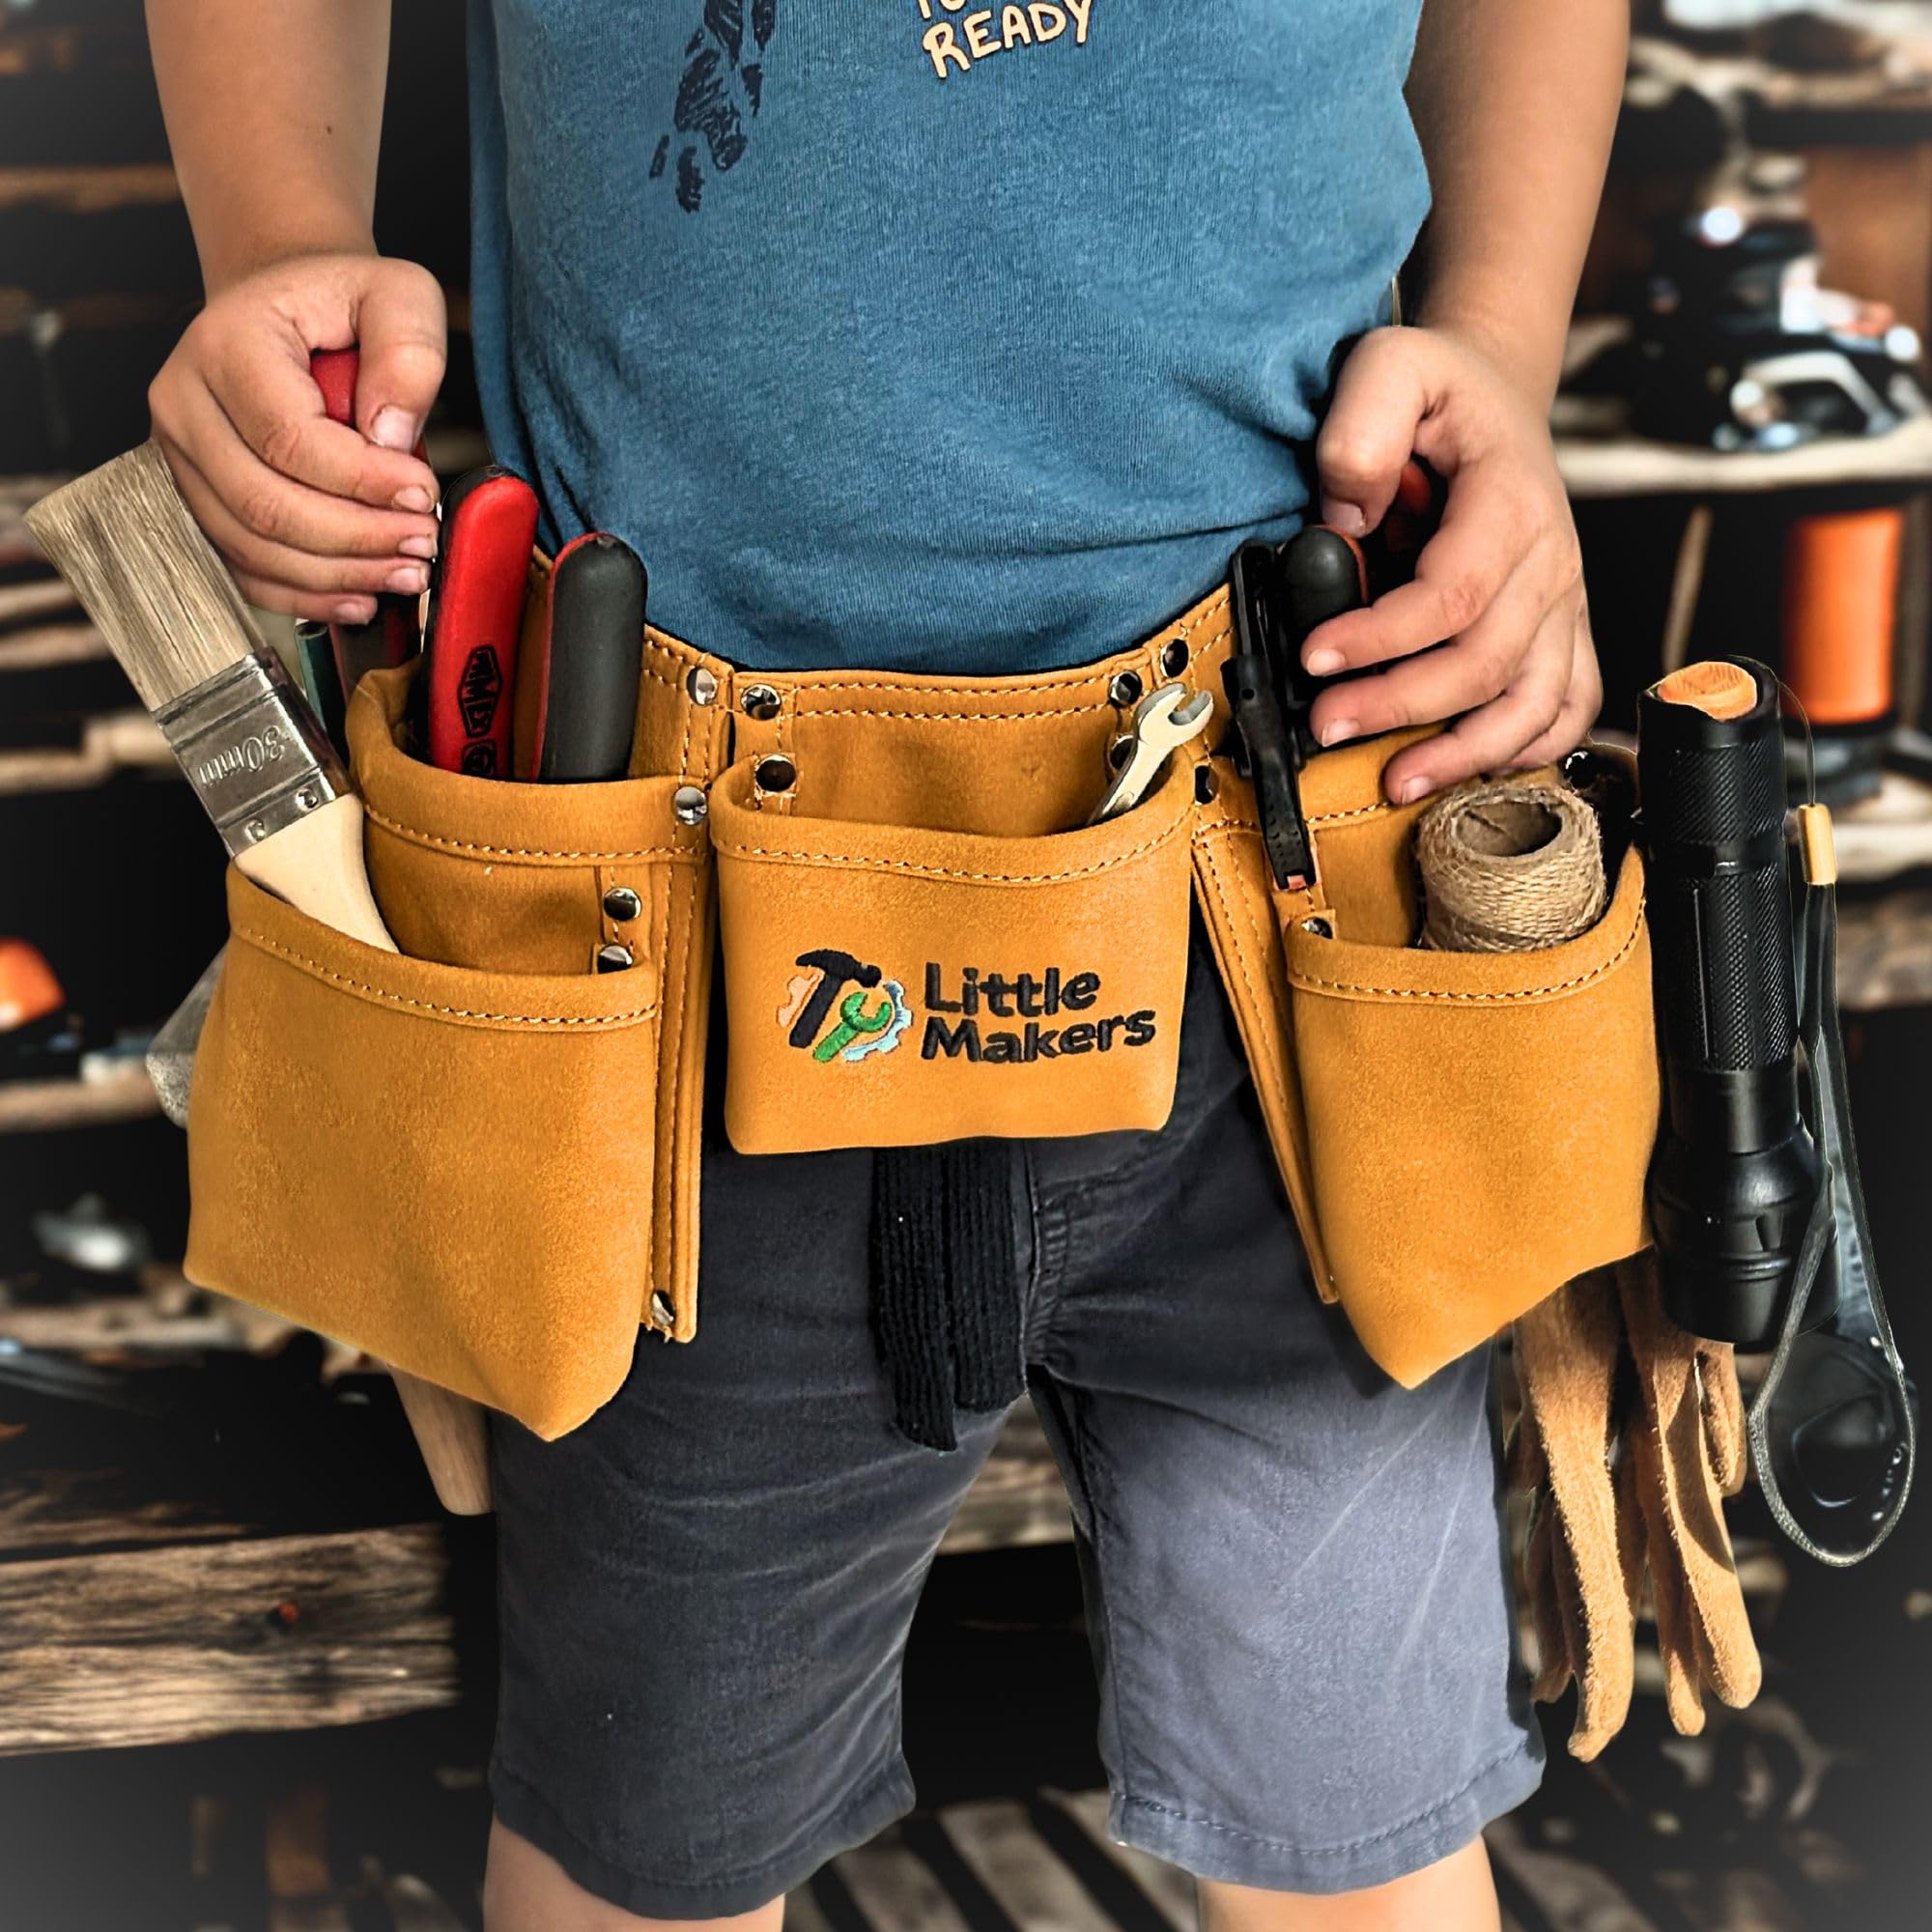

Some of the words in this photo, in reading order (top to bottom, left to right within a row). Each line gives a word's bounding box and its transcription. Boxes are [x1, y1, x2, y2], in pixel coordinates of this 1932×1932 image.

[922, 0, 1093, 78] READY
[924, 961, 1101, 1017] Little
[921, 1009, 1157, 1064] Makers
